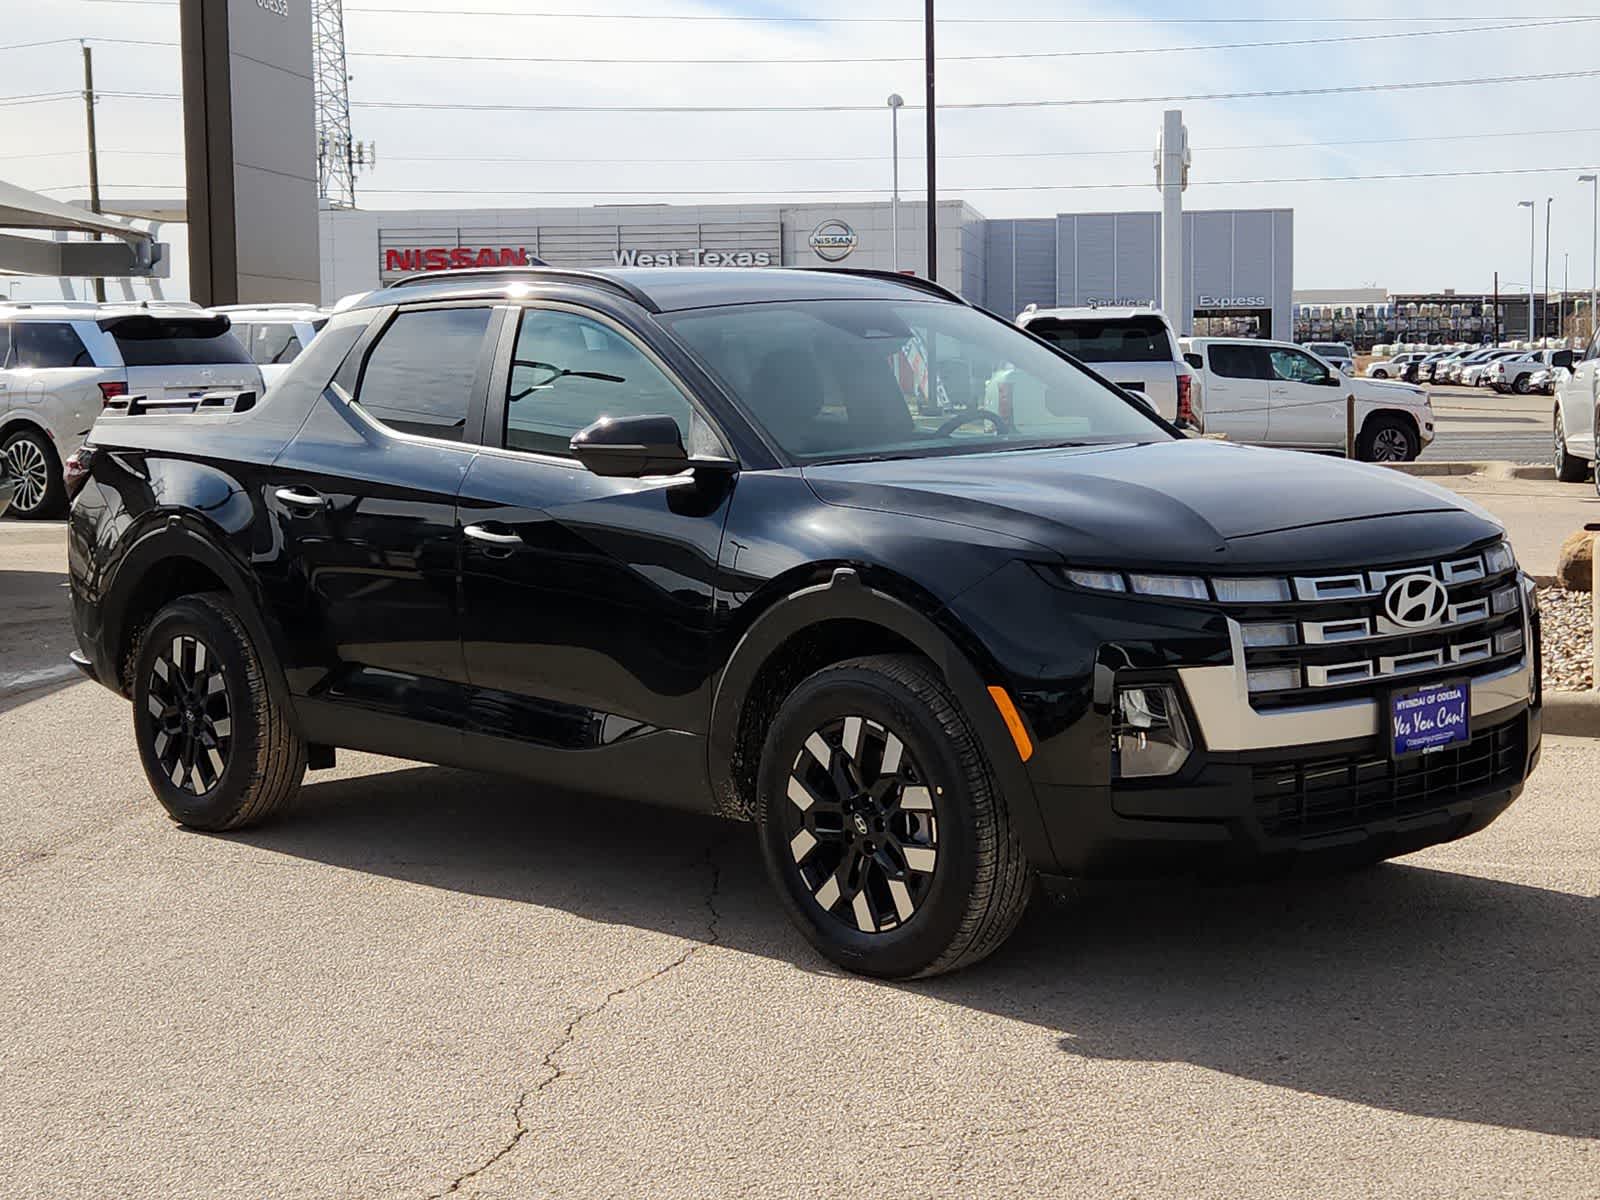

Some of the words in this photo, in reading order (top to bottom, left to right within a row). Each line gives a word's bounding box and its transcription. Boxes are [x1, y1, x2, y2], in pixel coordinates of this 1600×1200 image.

[386, 248, 528, 271] NISSAN
[612, 249, 680, 267] West
[688, 249, 771, 267] Texas
[1087, 295, 1145, 307] Service
[1199, 295, 1265, 308] Express
[1426, 694, 1436, 704] OF
[1394, 715, 1411, 737] Yes
[1413, 711, 1435, 733] You
[1436, 702, 1465, 728] Can!
